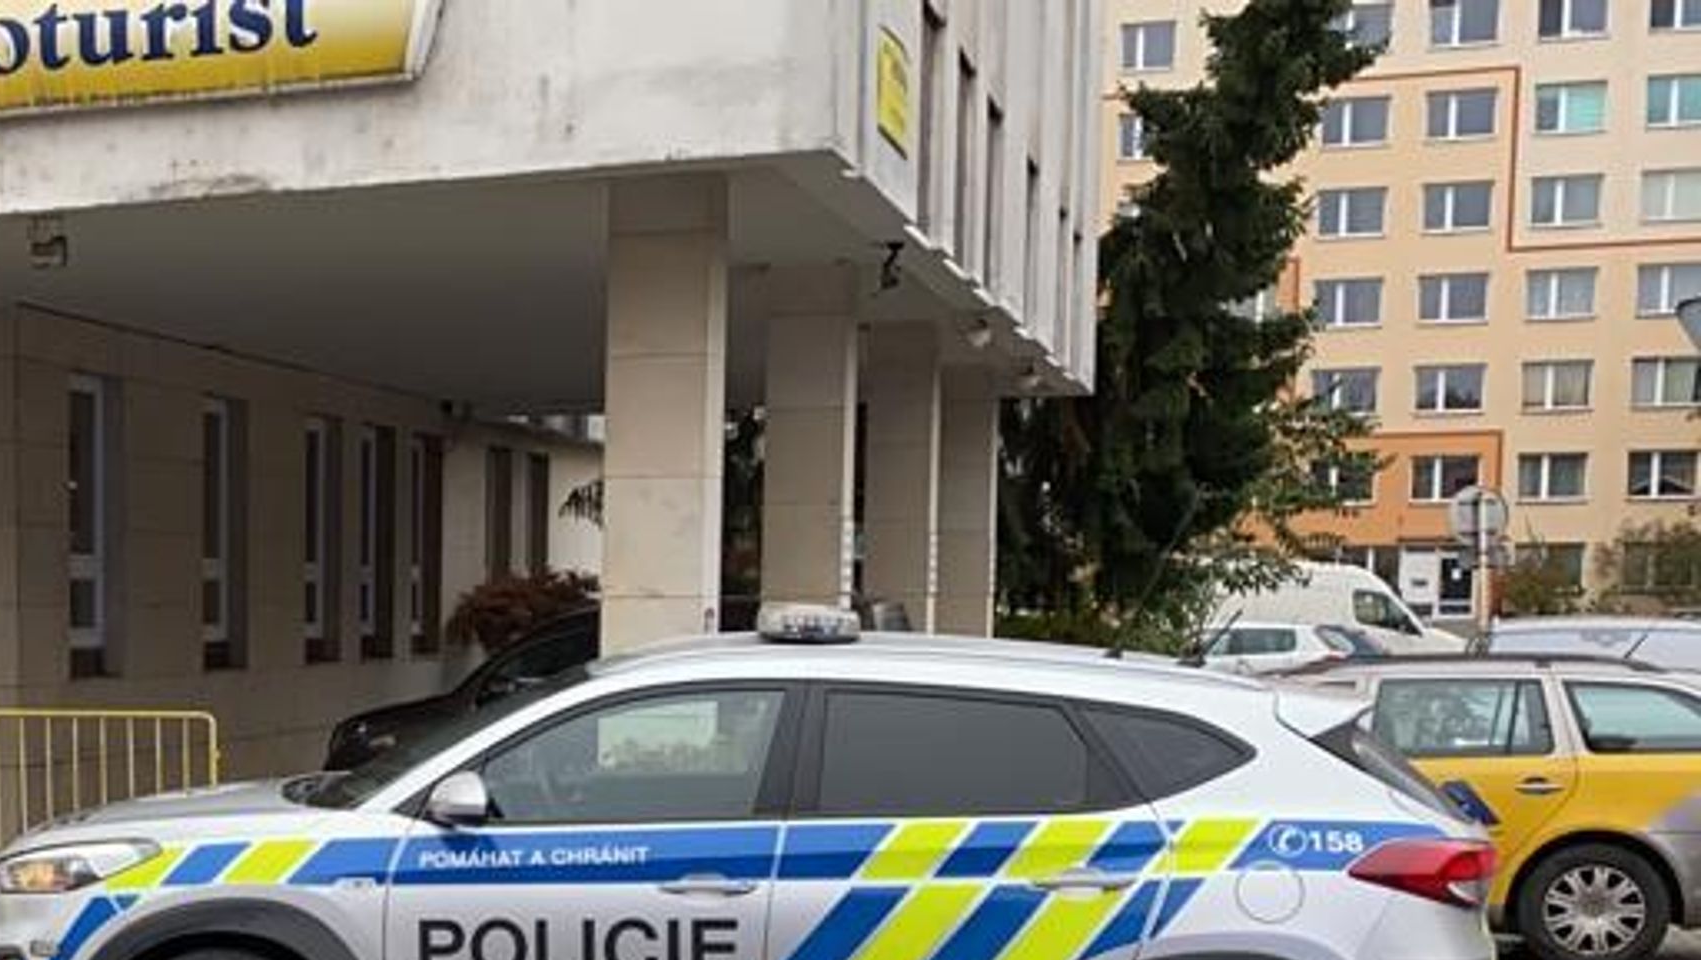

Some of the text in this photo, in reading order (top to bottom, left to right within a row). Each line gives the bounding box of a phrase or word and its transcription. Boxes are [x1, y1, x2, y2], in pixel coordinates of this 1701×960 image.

[1309, 830, 1364, 853] 158
[419, 844, 649, 869] POMÁHAT A CHRÁNIT
